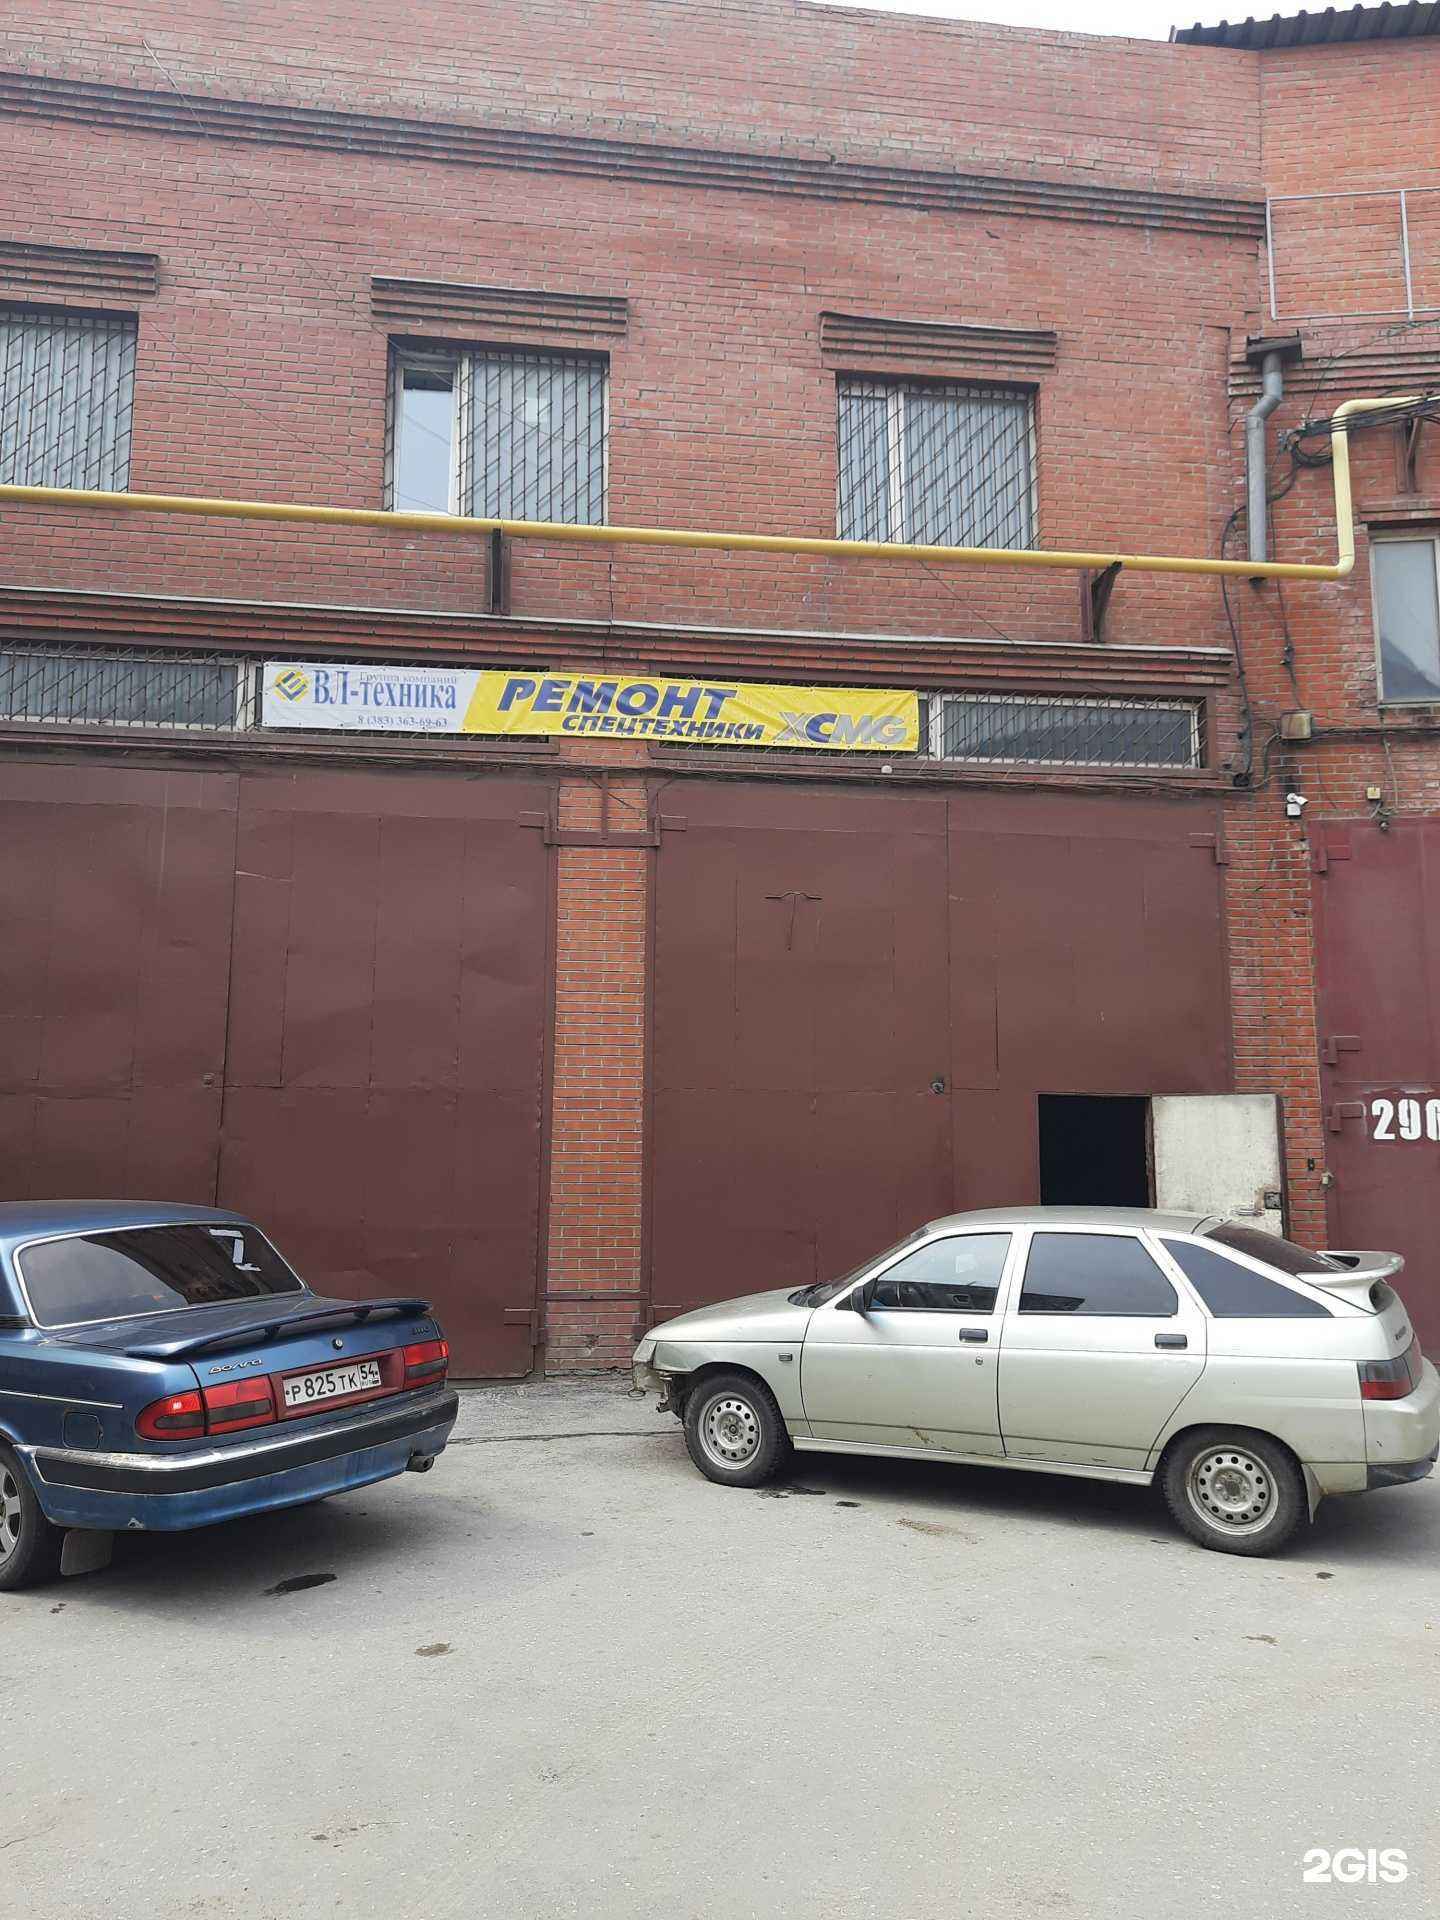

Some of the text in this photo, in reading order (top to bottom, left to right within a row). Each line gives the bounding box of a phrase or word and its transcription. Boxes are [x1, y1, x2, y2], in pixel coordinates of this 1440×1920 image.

[313, 669, 456, 709] ВЛ-техника
[498, 678, 737, 719] РЕМОНТ
[562, 714, 765, 740] СПЕЦТЕХНИКИ
[776, 712, 907, 744] XCMG
